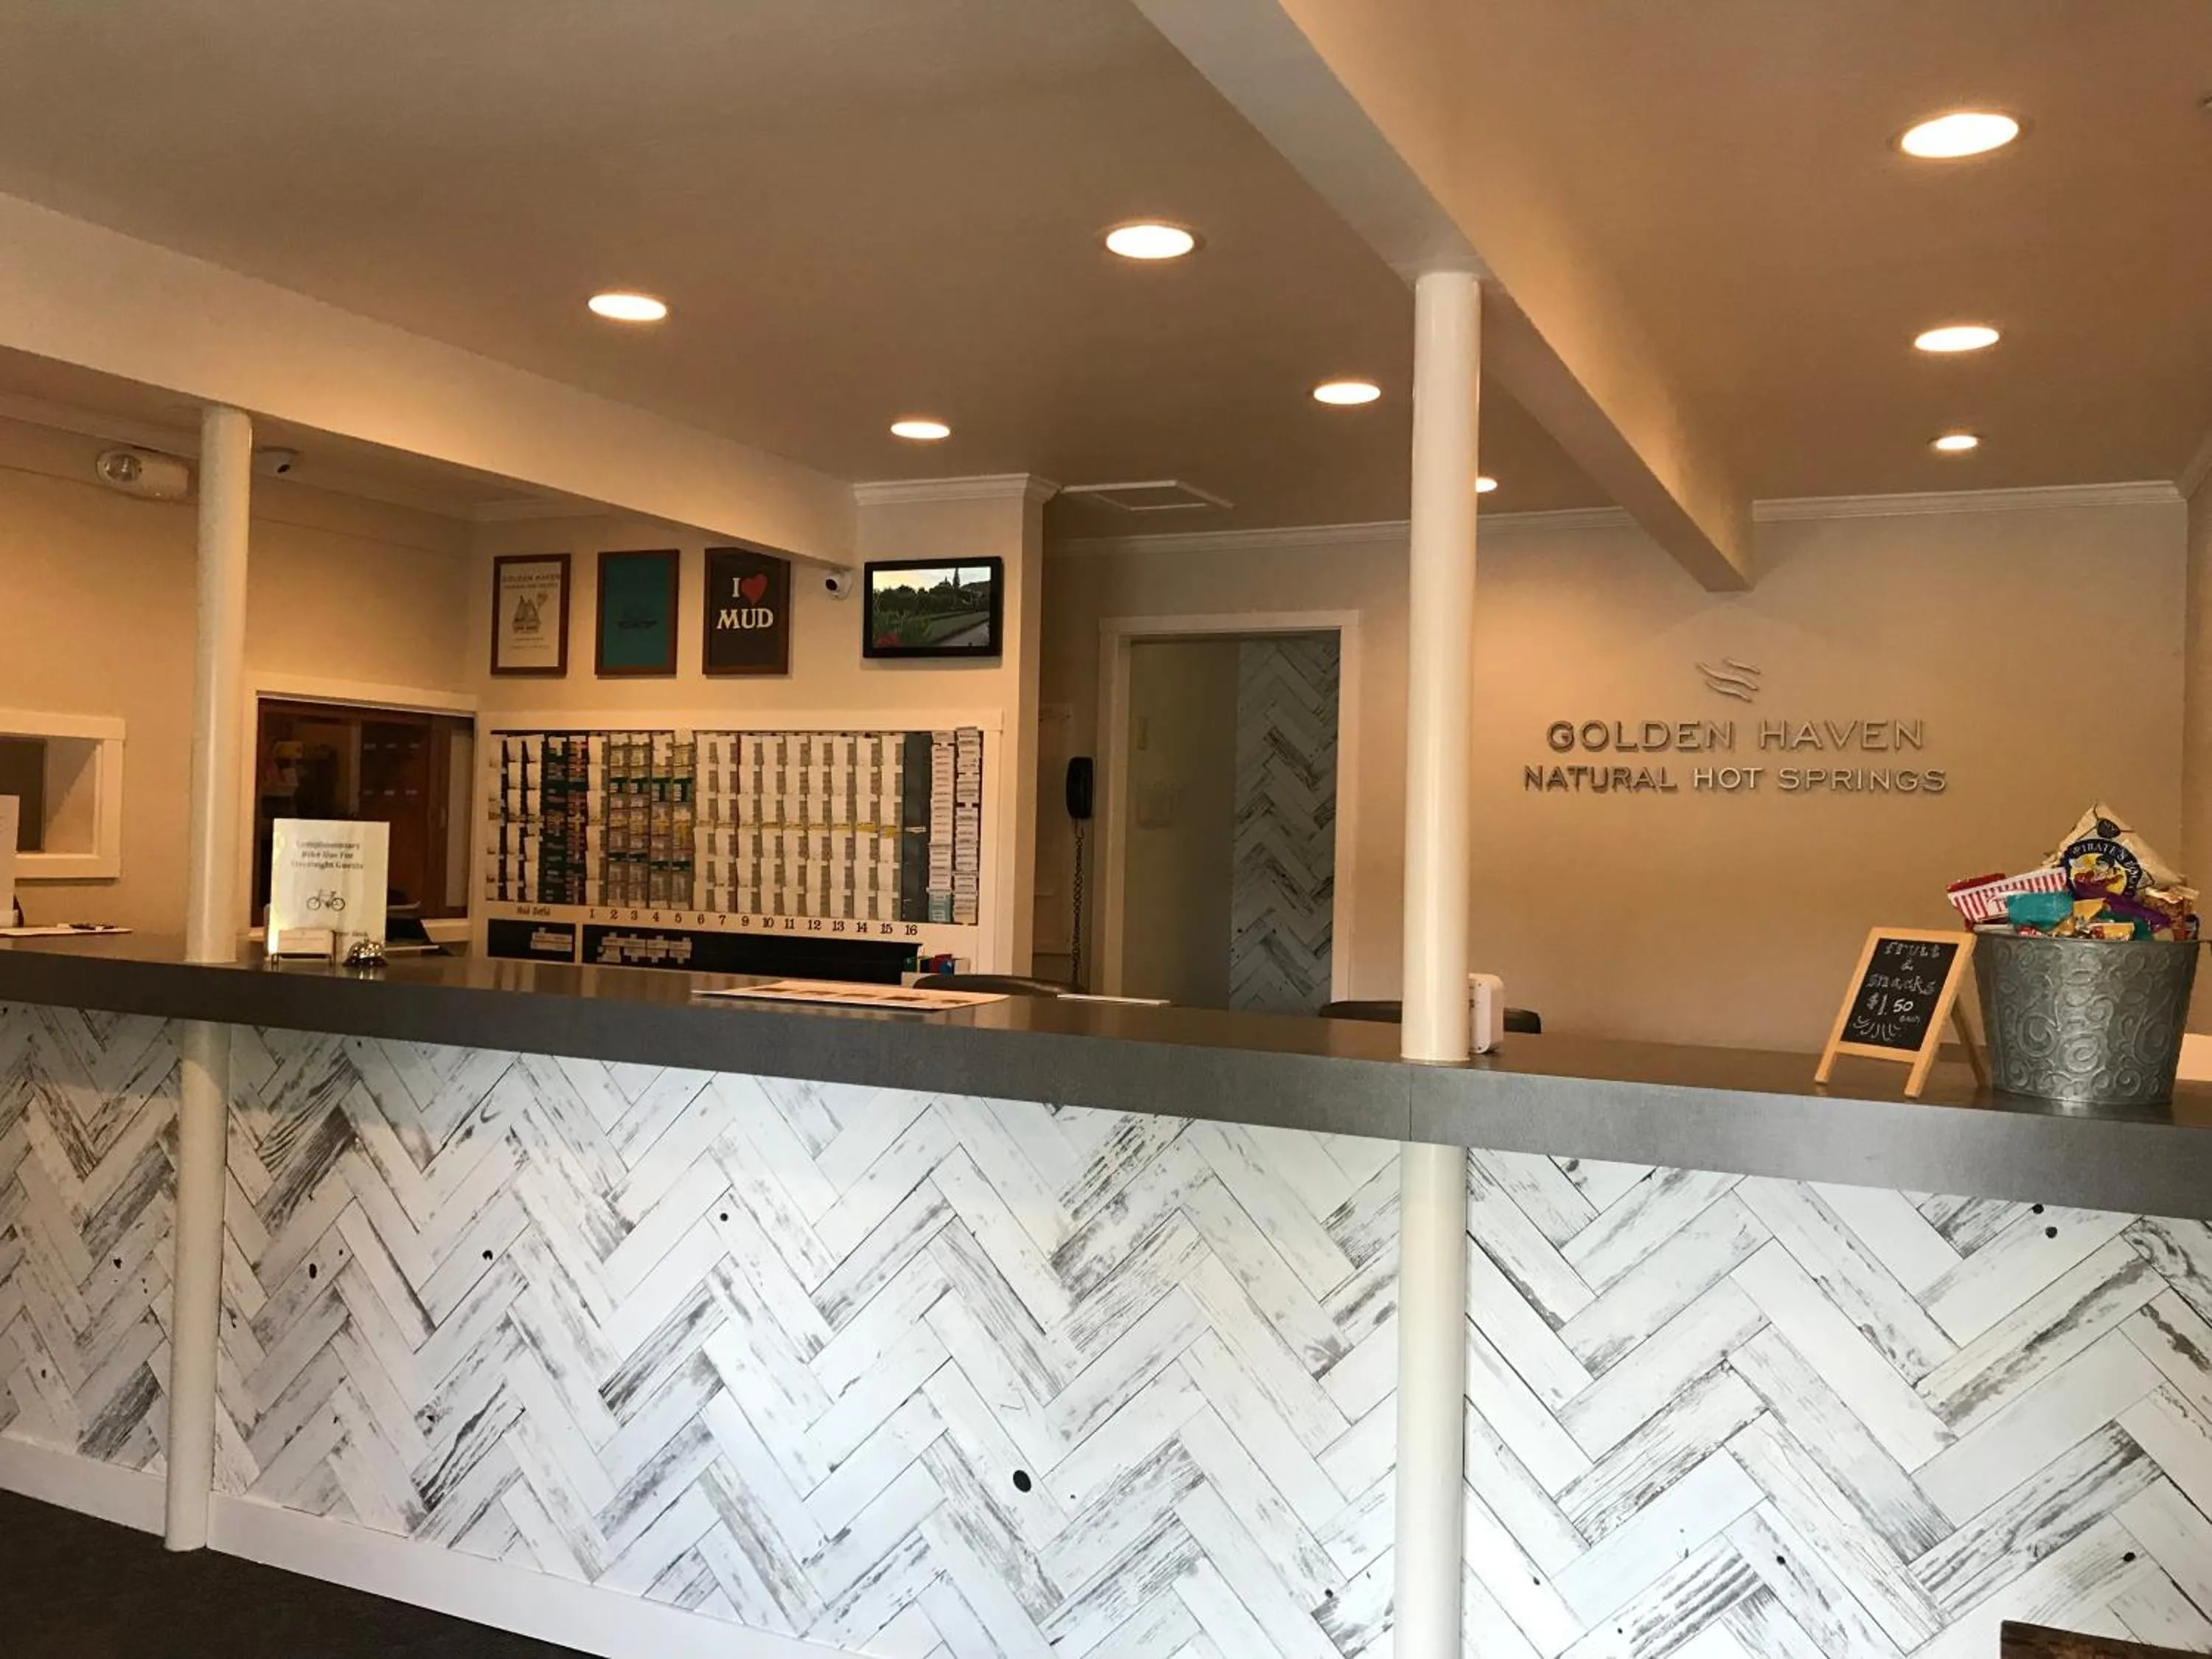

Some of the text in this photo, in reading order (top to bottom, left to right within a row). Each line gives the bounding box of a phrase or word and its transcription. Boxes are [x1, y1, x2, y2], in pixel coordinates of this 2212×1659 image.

[732, 577, 740, 598] I
[716, 608, 773, 629] MUD
[1548, 719, 1924, 751] GOLDEN HAVEN
[1524, 765, 1947, 792] NATURAL HOT SPRINGS
[589, 908, 918, 936] 1 2 3 4 5 6 7 9 10 11 12 13 14 15 16
